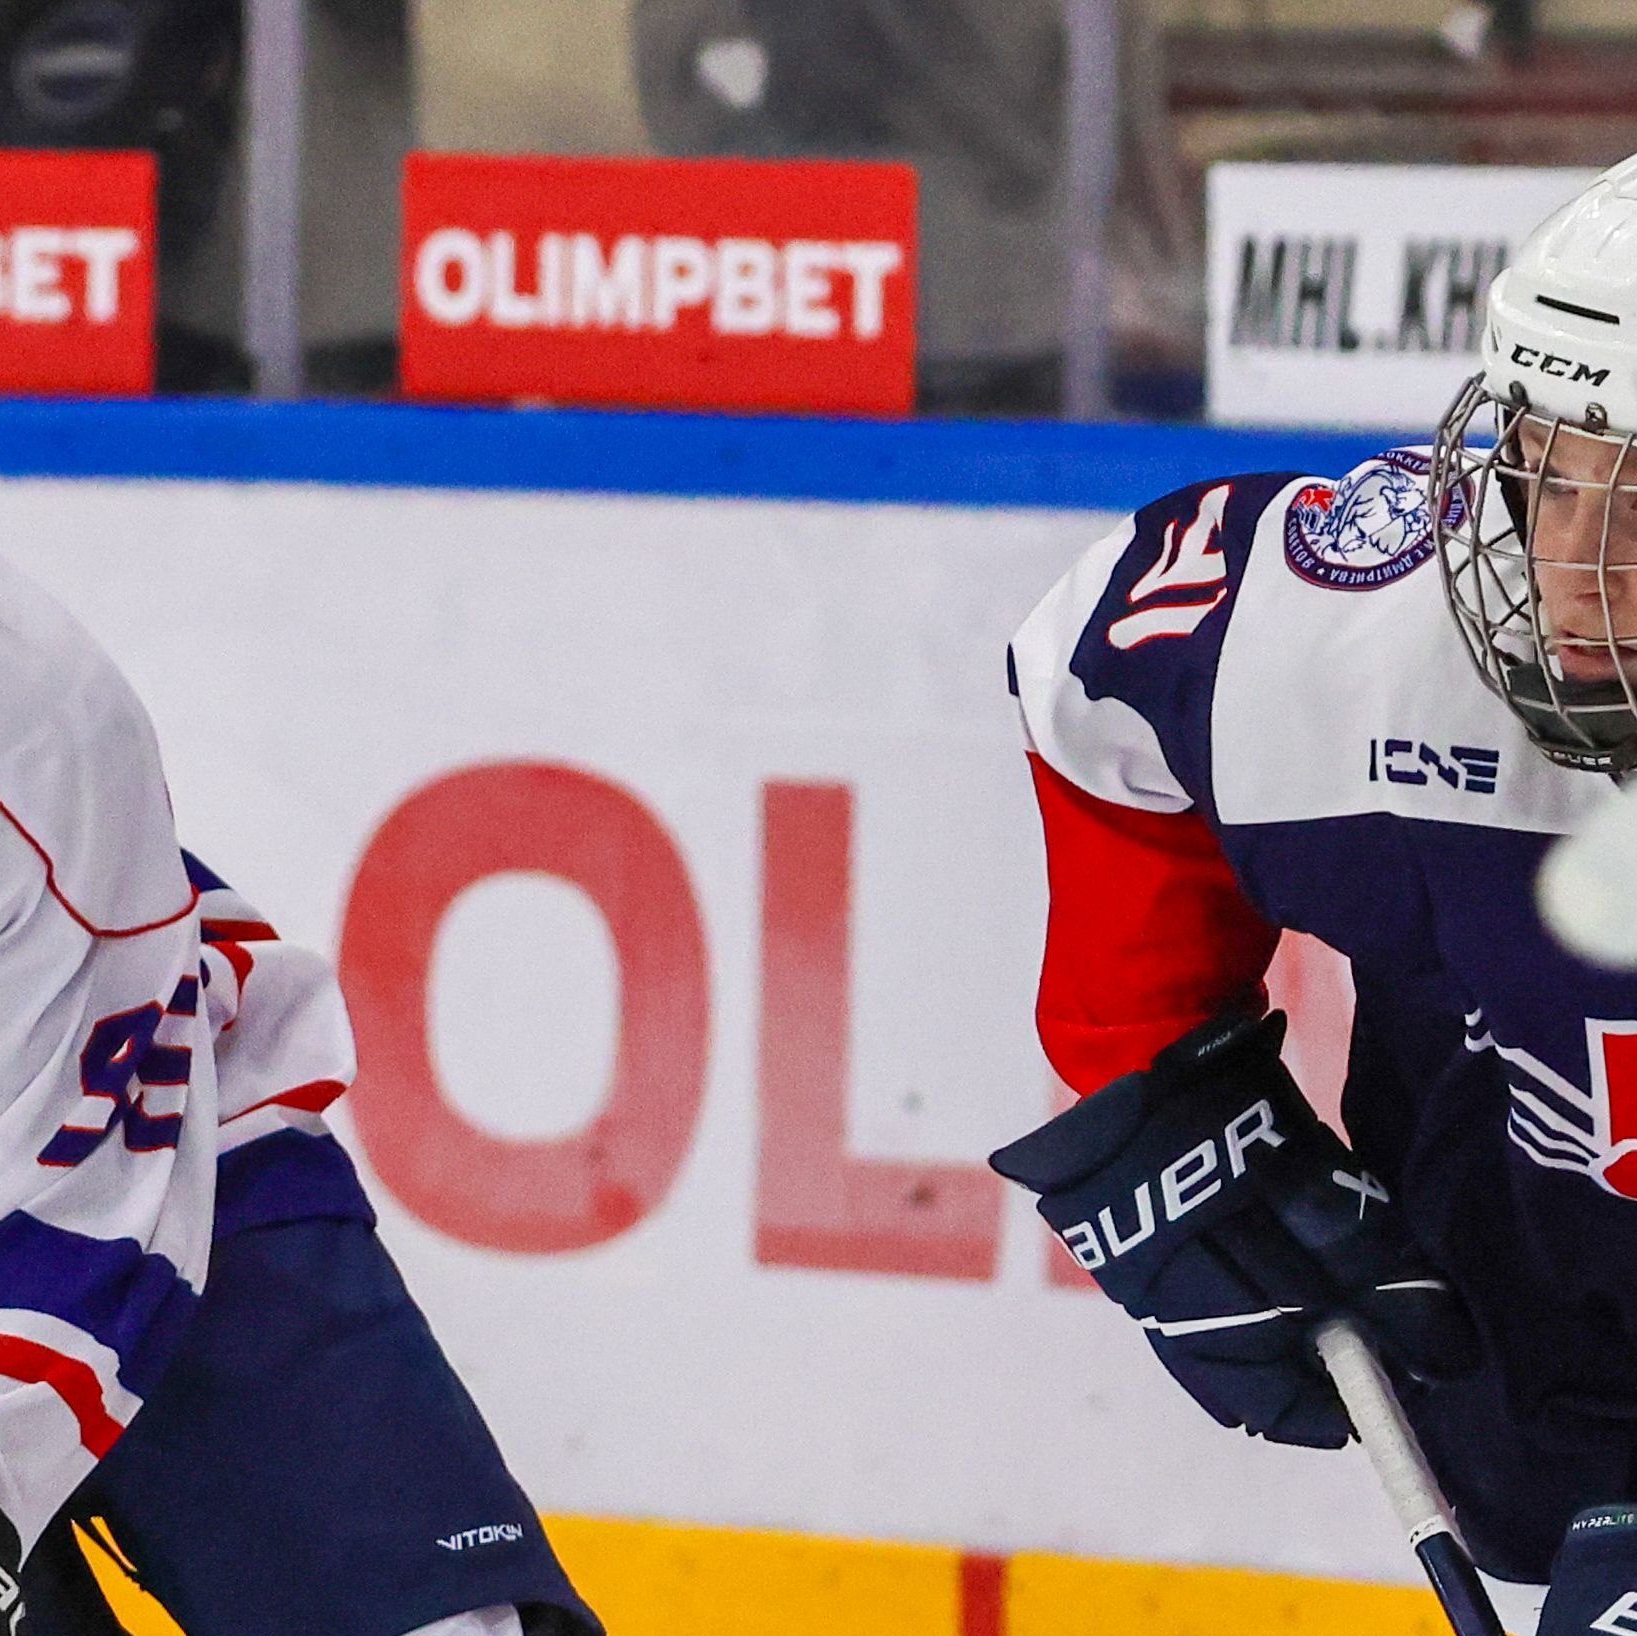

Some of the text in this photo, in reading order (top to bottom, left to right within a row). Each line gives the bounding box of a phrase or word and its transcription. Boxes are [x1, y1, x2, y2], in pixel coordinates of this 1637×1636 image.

[415, 227, 904, 341] OLIMPBET
[1510, 344, 1611, 389] CCM
[1054, 1099, 1286, 1270] AUER
